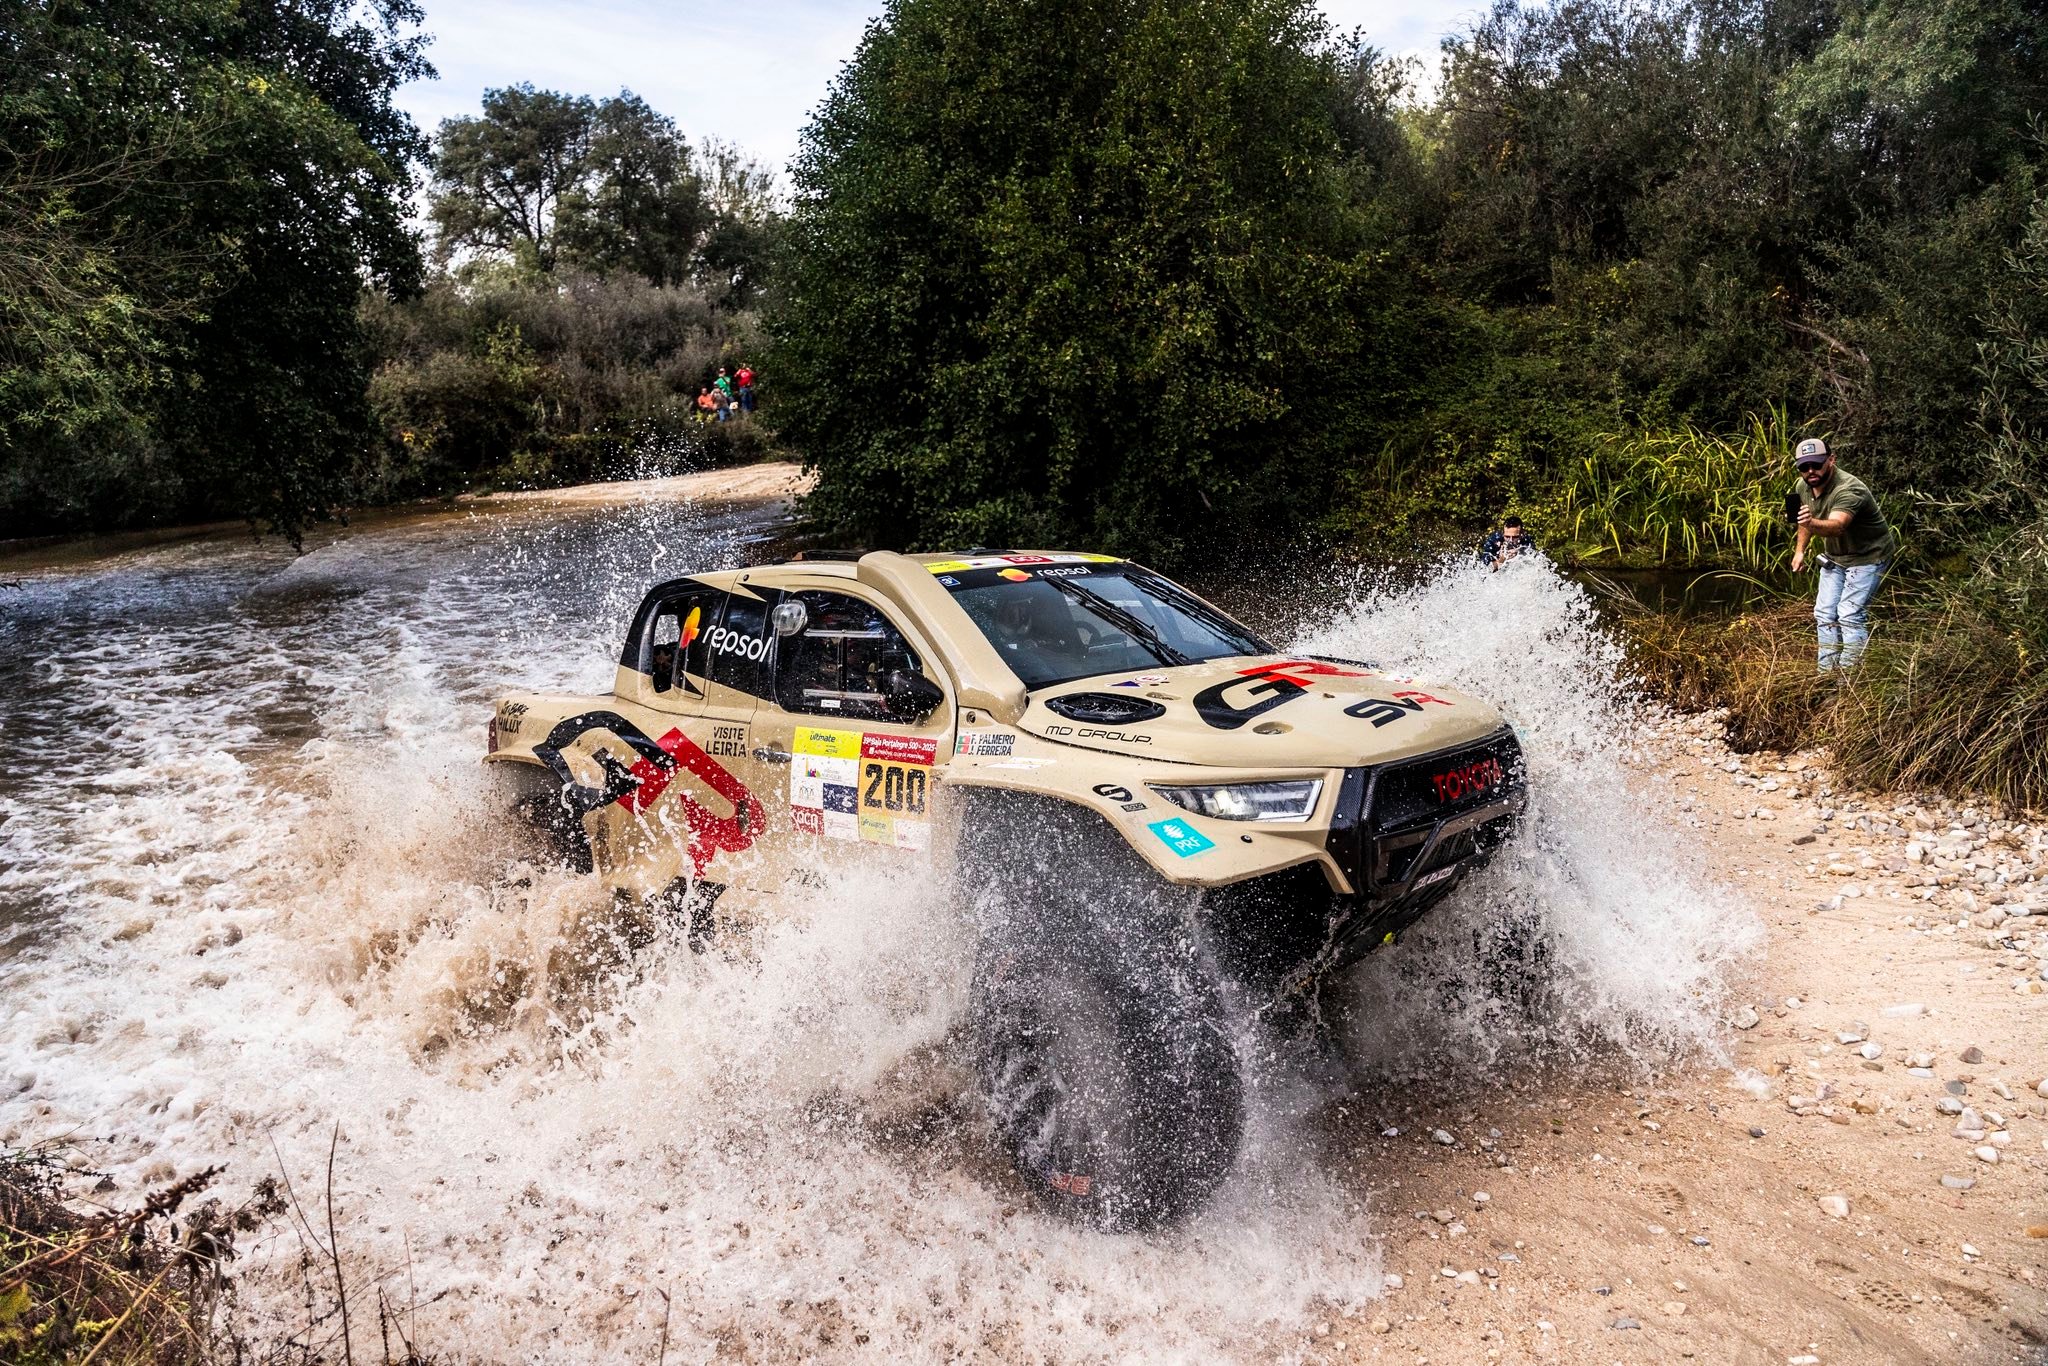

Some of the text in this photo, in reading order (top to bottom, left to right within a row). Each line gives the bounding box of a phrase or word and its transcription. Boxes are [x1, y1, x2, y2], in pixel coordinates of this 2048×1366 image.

[1036, 566, 1092, 577] repsol
[702, 625, 773, 663] repsol
[1193, 661, 1373, 730] GR
[713, 726, 745, 740] VISITE
[1045, 725, 1073, 735] MD
[809, 733, 836, 743] ultimate
[882, 739, 908, 750] Portalegre
[908, 742, 918, 750] 500
[971, 734, 1016, 745] F. PALMEIRO
[705, 740, 747, 758] LEIRIA
[977, 745, 1012, 756] FERREIRA
[1432, 757, 1504, 804] TOYOTA
[864, 763, 926, 815] 200
[1174, 836, 1201, 852] PRF
